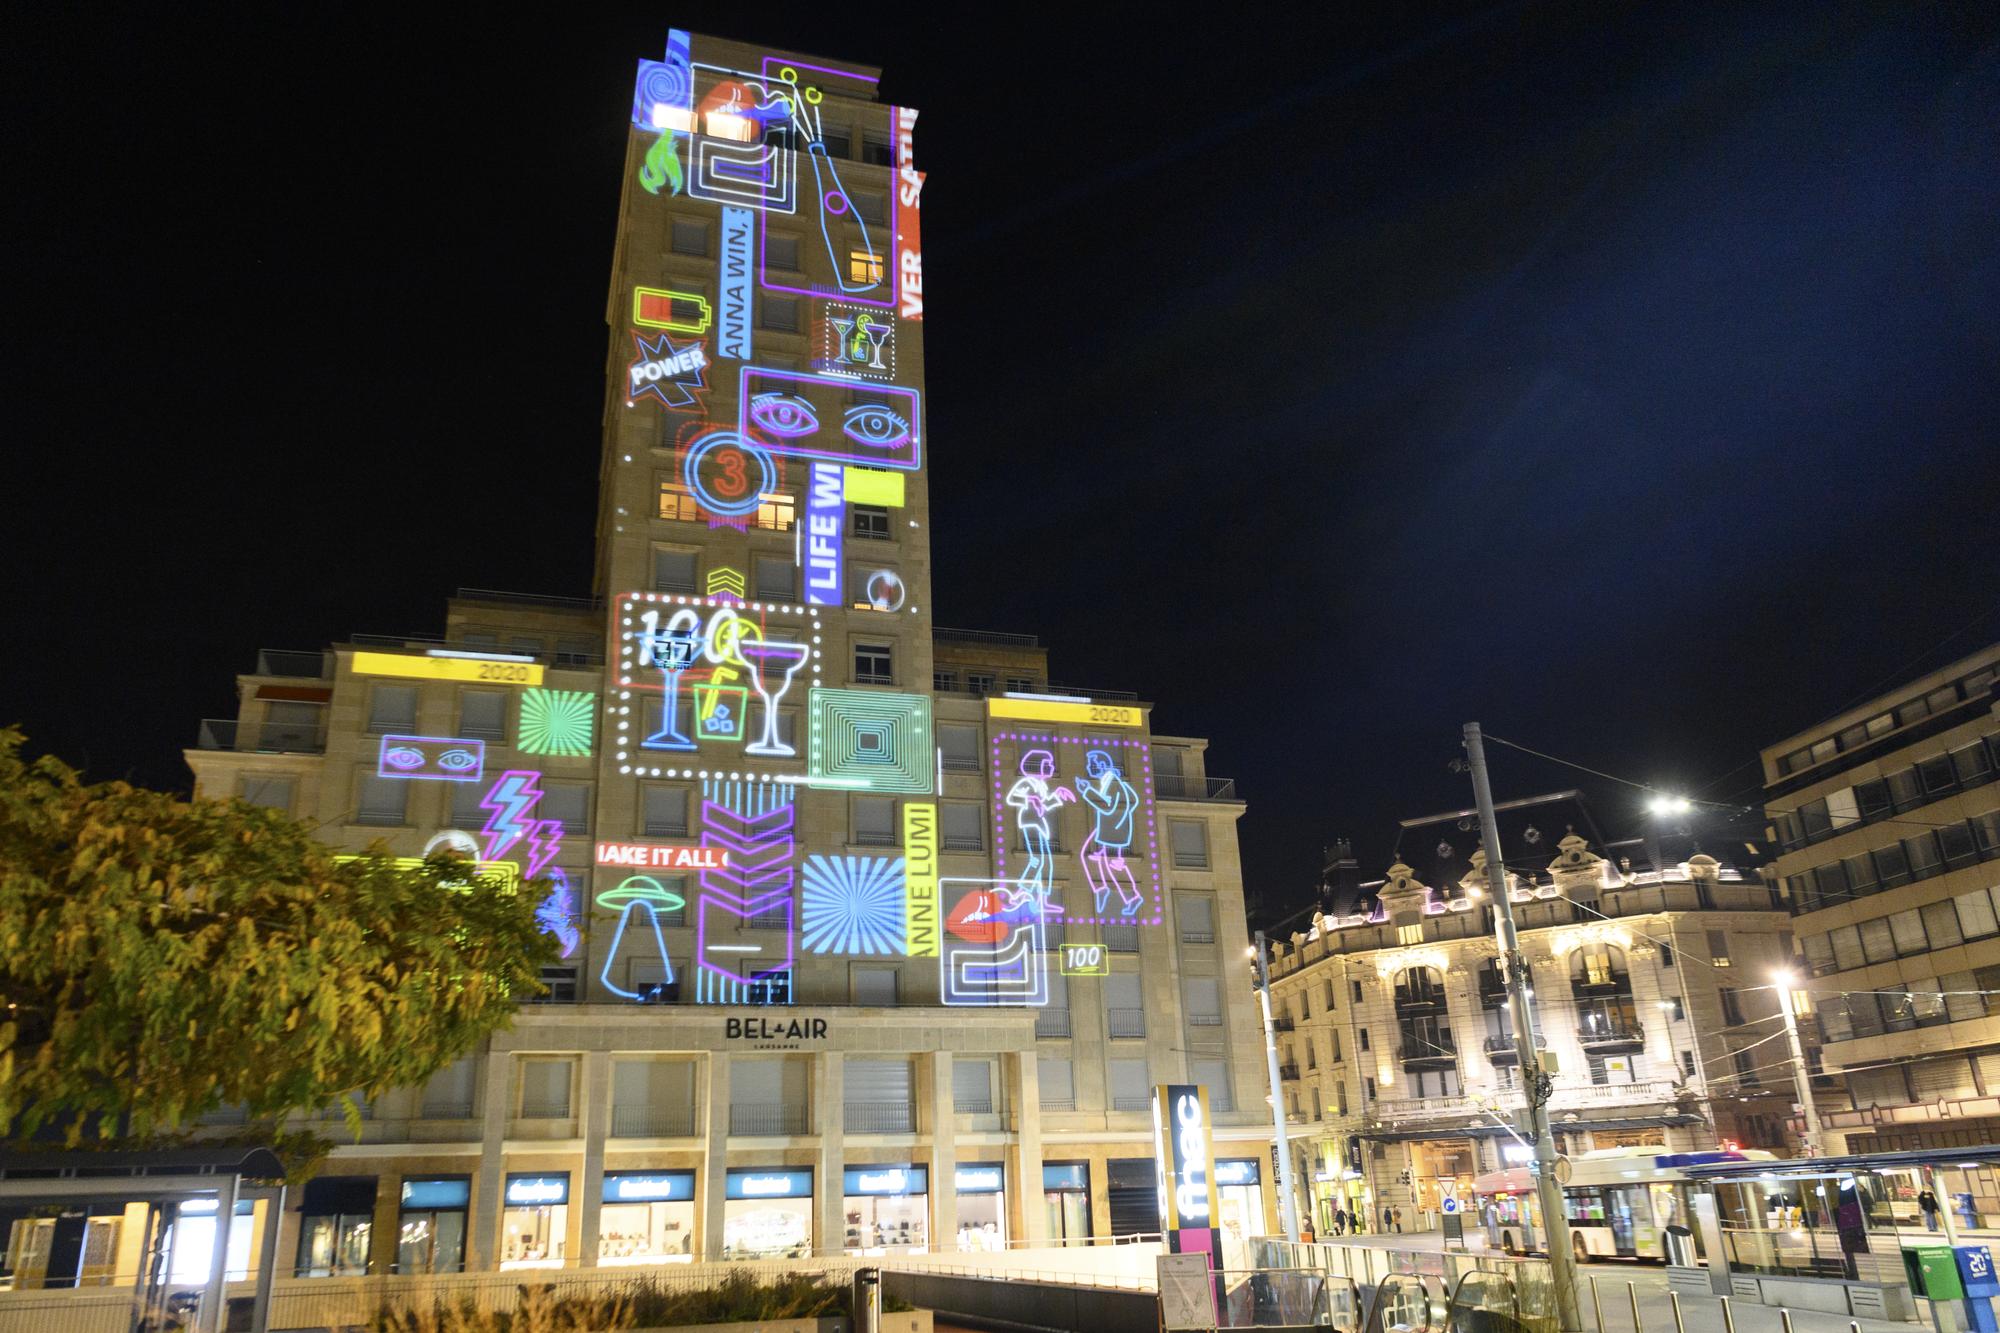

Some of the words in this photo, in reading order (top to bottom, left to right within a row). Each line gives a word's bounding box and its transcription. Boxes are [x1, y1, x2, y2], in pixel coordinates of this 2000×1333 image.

[727, 222, 748, 278] WIN,
[725, 285, 744, 360] ANNA
[630, 350, 707, 385] POWER
[713, 449, 747, 496] 3
[810, 514, 836, 589] LIFE
[479, 664, 528, 681] 2020
[1089, 707, 1130, 723] 2020
[652, 848, 674, 866] IT
[674, 848, 718, 868] ALL
[910, 808, 931, 877] LUMI
[1068, 946, 1100, 969] 100
[1177, 1094, 1209, 1220] fnac
